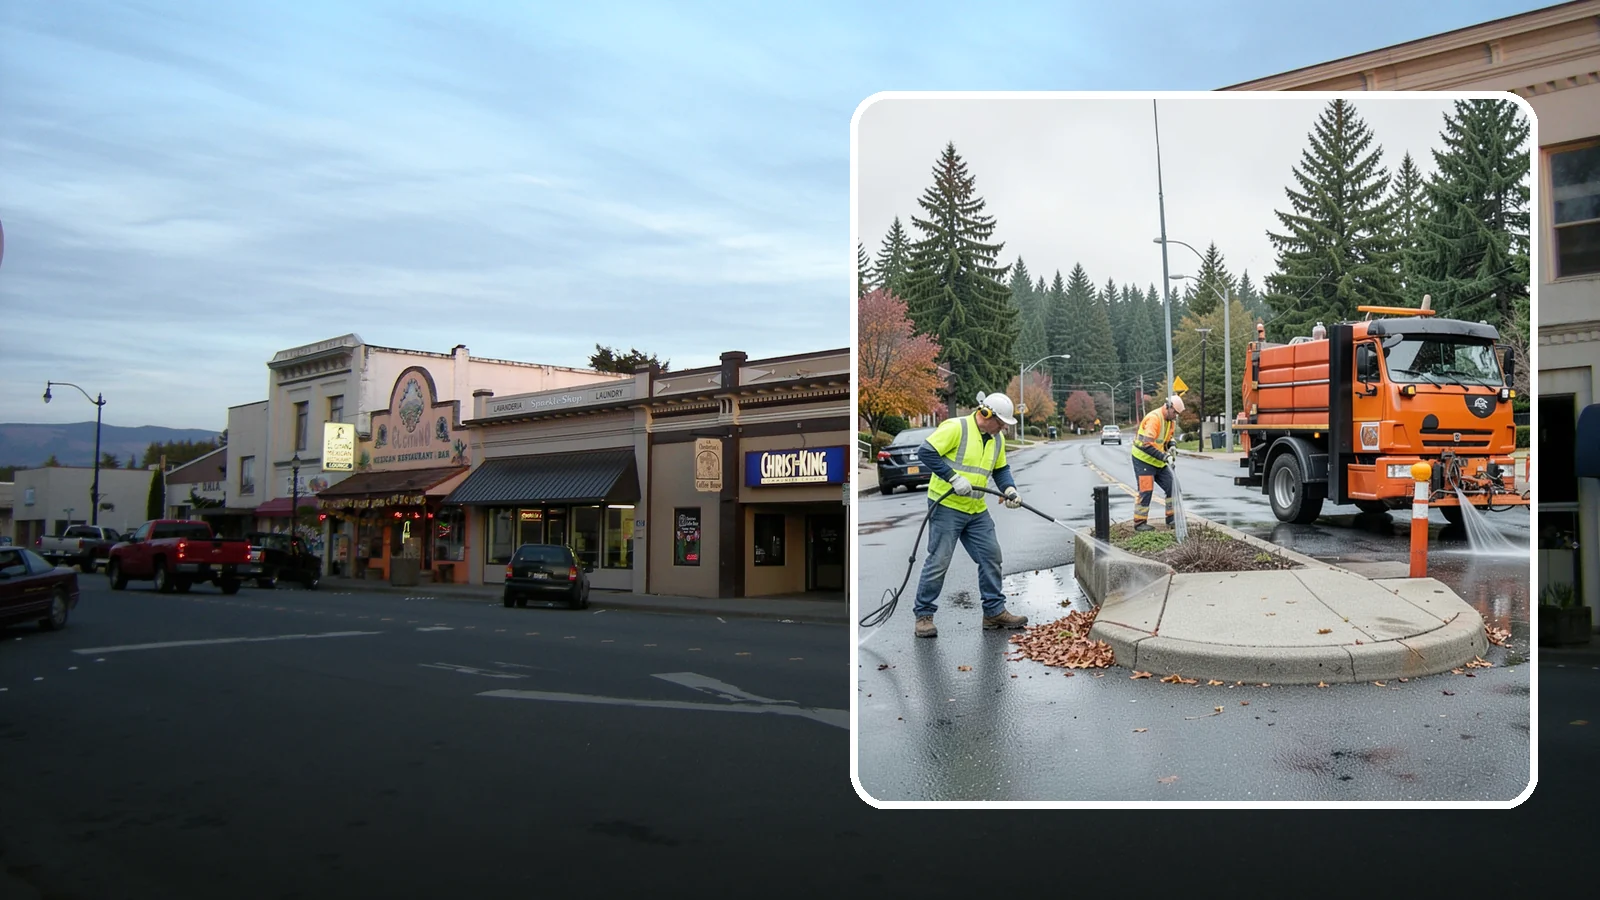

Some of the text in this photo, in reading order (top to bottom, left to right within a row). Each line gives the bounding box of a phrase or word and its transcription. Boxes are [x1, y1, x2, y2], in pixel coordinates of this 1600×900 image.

[595, 389, 623, 400] LAUNDRY
[493, 402, 522, 412] LAVANDERIA
[531, 394, 582, 409] Sparkle Shop
[373, 450, 450, 464] MEXICAN RESTAURANT BAR
[799, 450, 827, 476] KING
[696, 480, 722, 489] Coffee House
